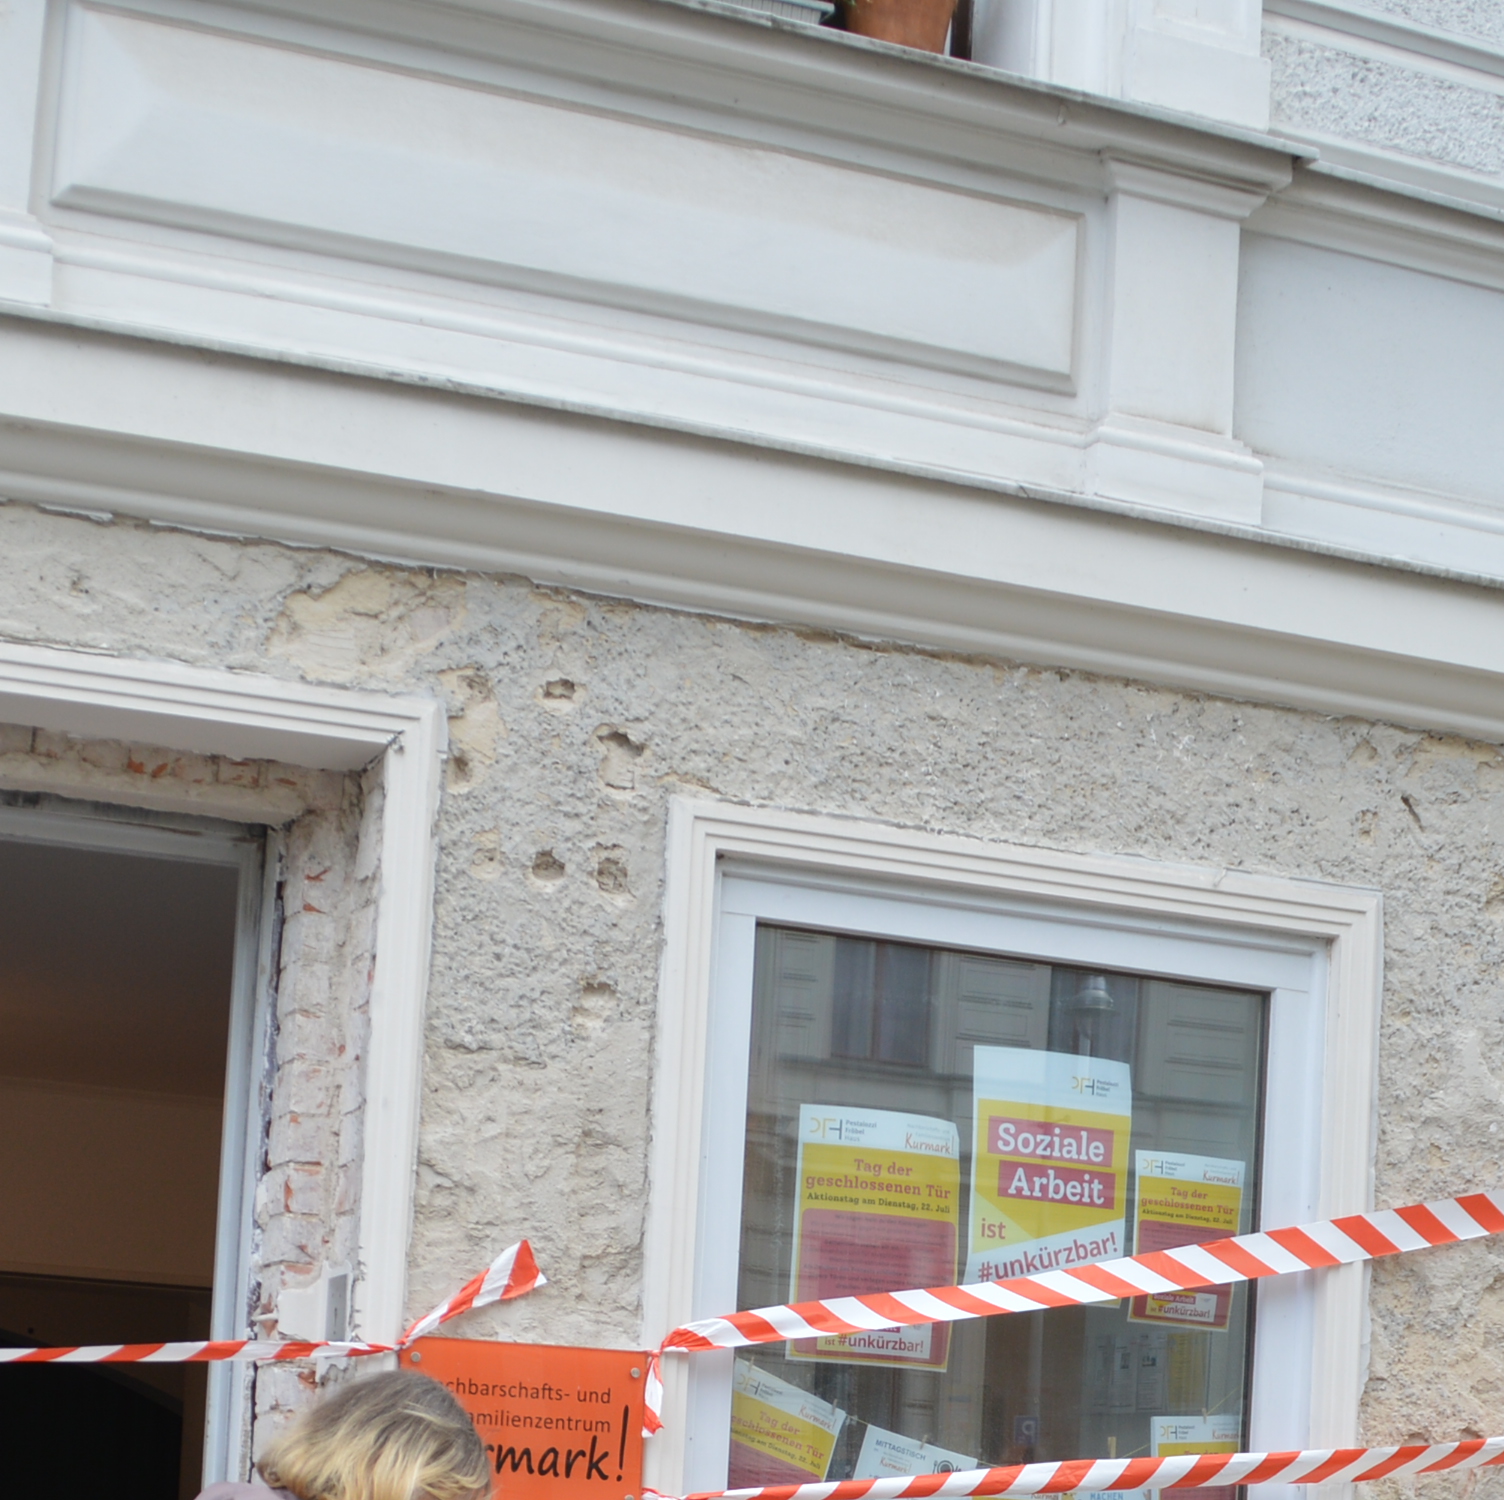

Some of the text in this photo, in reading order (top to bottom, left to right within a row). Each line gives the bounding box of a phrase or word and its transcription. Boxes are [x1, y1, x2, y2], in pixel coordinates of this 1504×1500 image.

[904, 1131, 955, 1155] Kurmark!
[997, 1122, 1105, 1162] Soziale
[854, 1158, 913, 1177] Tag der
[805, 1174, 951, 1199] geschlossenen Tür
[1007, 1167, 1105, 1204] Arbeit
[1171, 1187, 1208, 1199] Tag der
[807, 1192, 860, 1205] Aktionstag
[878, 1198, 919, 1211] Dienstag,
[920, 1202, 932, 1211] 22.
[935, 1205, 951, 1214] Juli
[1141, 1197, 1235, 1215] geschlossenen Tür
[981, 1217, 1006, 1239] ist
[978, 1232, 1118, 1282] #unkürzbar!
[1158, 1304, 1211, 1318] #unkürzbar!
[825, 1333, 924, 1353] ist #unkürzbar!
[444, 1377, 611, 1404] chbarschafts- und
[468, 1409, 611, 1433] amilienzentrum
[760, 1411, 800, 1435] Tag der
[485, 1404, 630, 1482] mark!
[732, 1415, 825, 1460] eschlossenen Tür
[875, 1439, 927, 1461] MITTAGSTISCH
[1090, 1492, 1124, 1500] MACHEN
